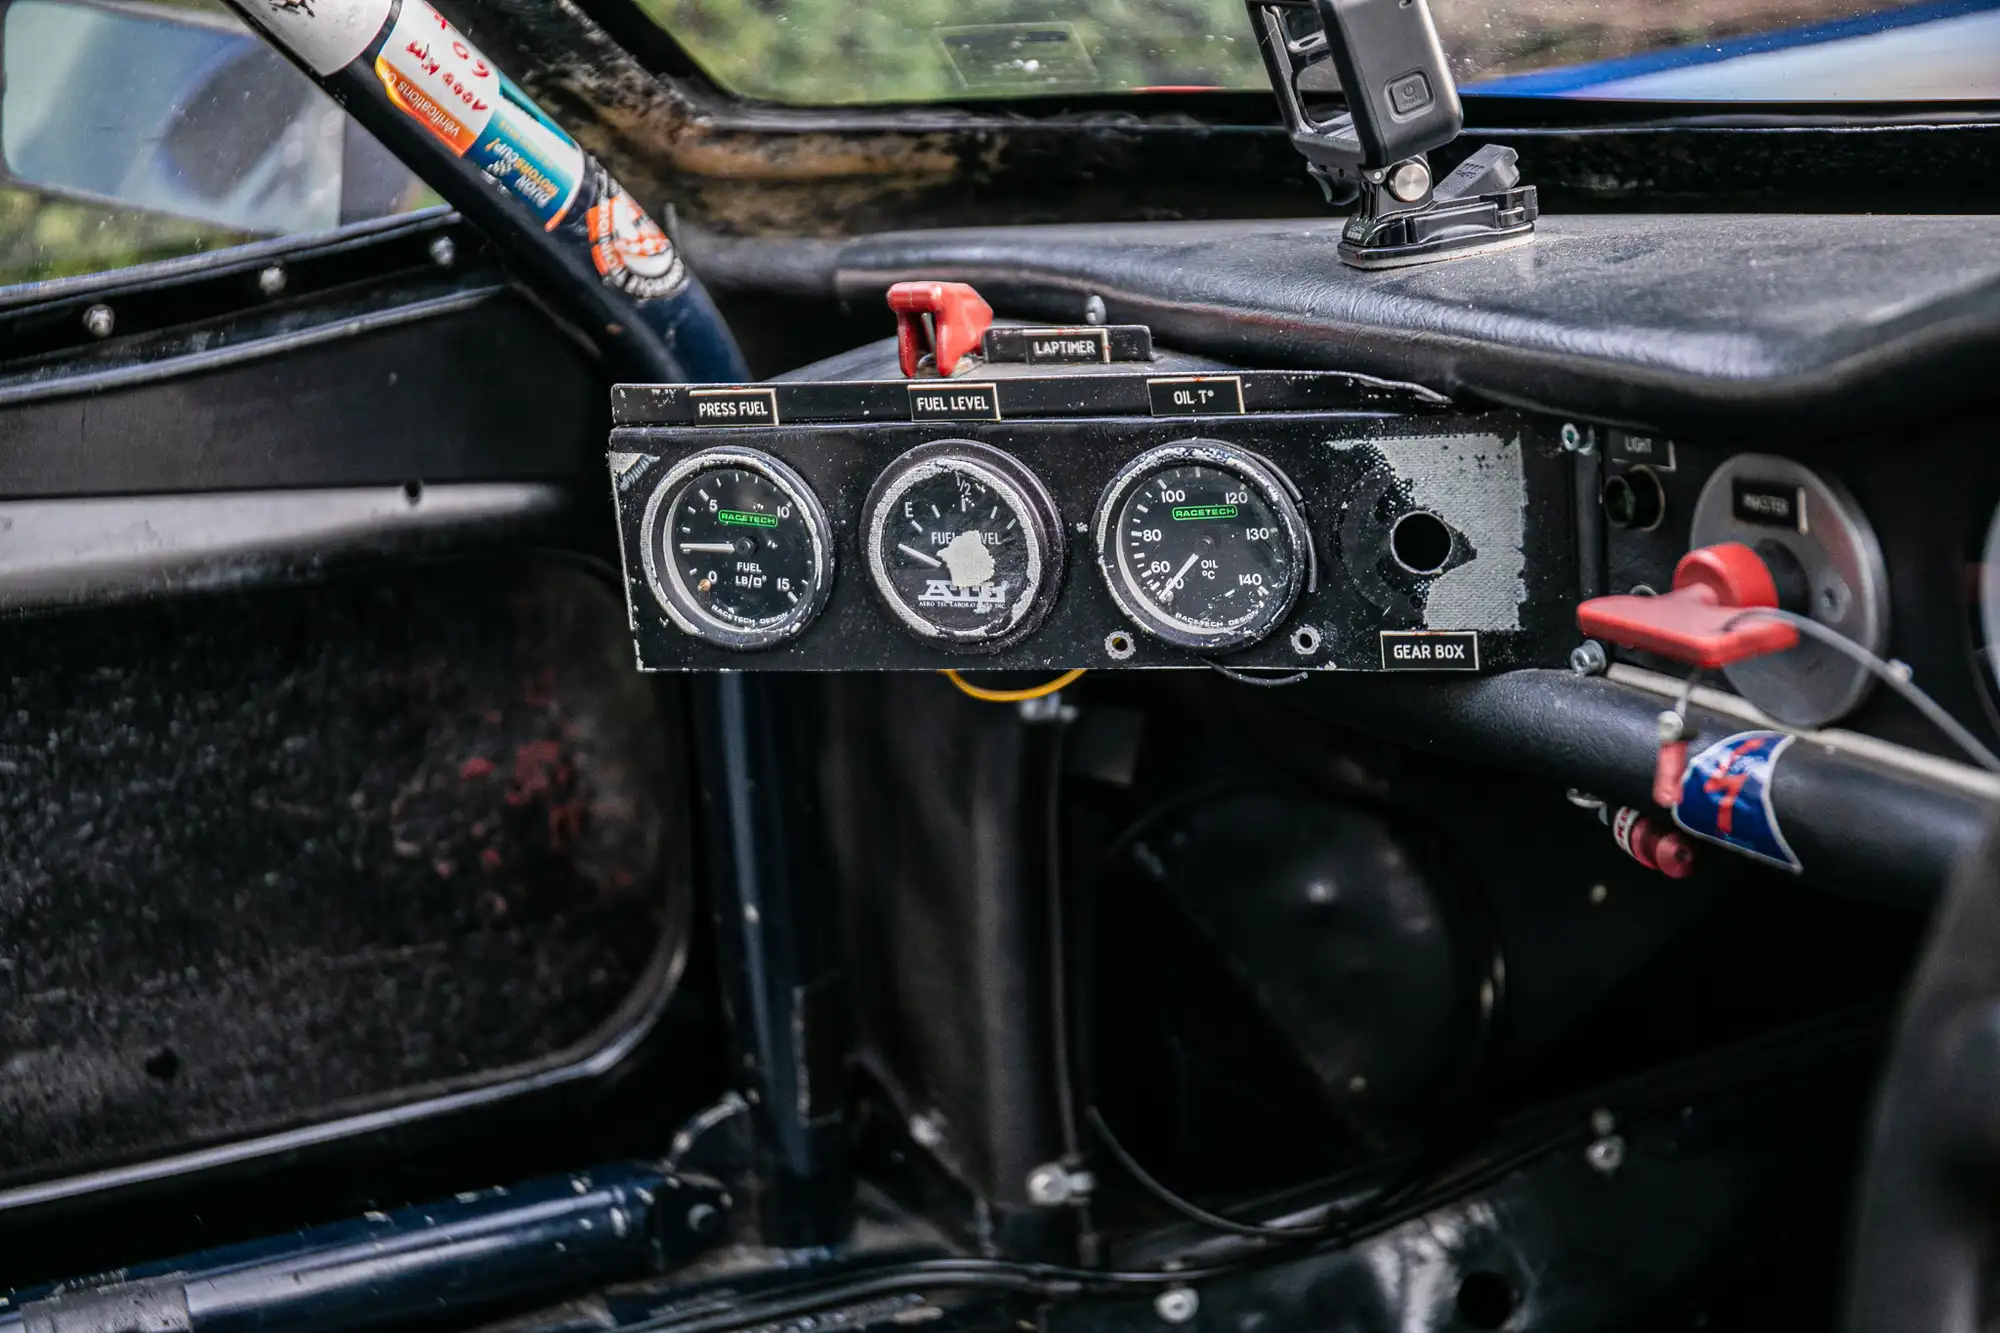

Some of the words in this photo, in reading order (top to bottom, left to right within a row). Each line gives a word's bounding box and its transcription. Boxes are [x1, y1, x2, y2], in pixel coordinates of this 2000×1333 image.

[1033, 340, 1096, 356] LAPTIMER
[917, 396, 948, 411] FUEL
[950, 396, 989, 410] LEVEL
[1173, 390, 1195, 405] OIL
[699, 402, 737, 417] PRESS
[739, 401, 768, 416] FUEL
[1624, 435, 1652, 453] LIGHT
[955, 471, 972, 496] 1/2
[1161, 489, 1186, 503] 100
[1225, 491, 1248, 505] 120
[709, 499, 718, 511] 5
[905, 501, 913, 518] E
[721, 513, 776, 525] RACETECH
[777, 506, 790, 519] 10
[1175, 508, 1235, 518] RACETECH
[1143, 529, 1162, 541] 80
[1245, 527, 1269, 541] 130
[737, 561, 762, 573] FUEL
[1151, 561, 1170, 573] 60
[1201, 559, 1218, 569] OIL
[708, 571, 718, 584] 0
[777, 577, 790, 591] 15
[1238, 573, 1262, 586] 140
[711, 604, 756, 625] RACETECH
[759, 611, 788, 625] DESIGN
[1175, 612, 1223, 628] RACETECH
[1393, 644, 1431, 659] GEAR
[1435, 644, 1465, 659] BOX
